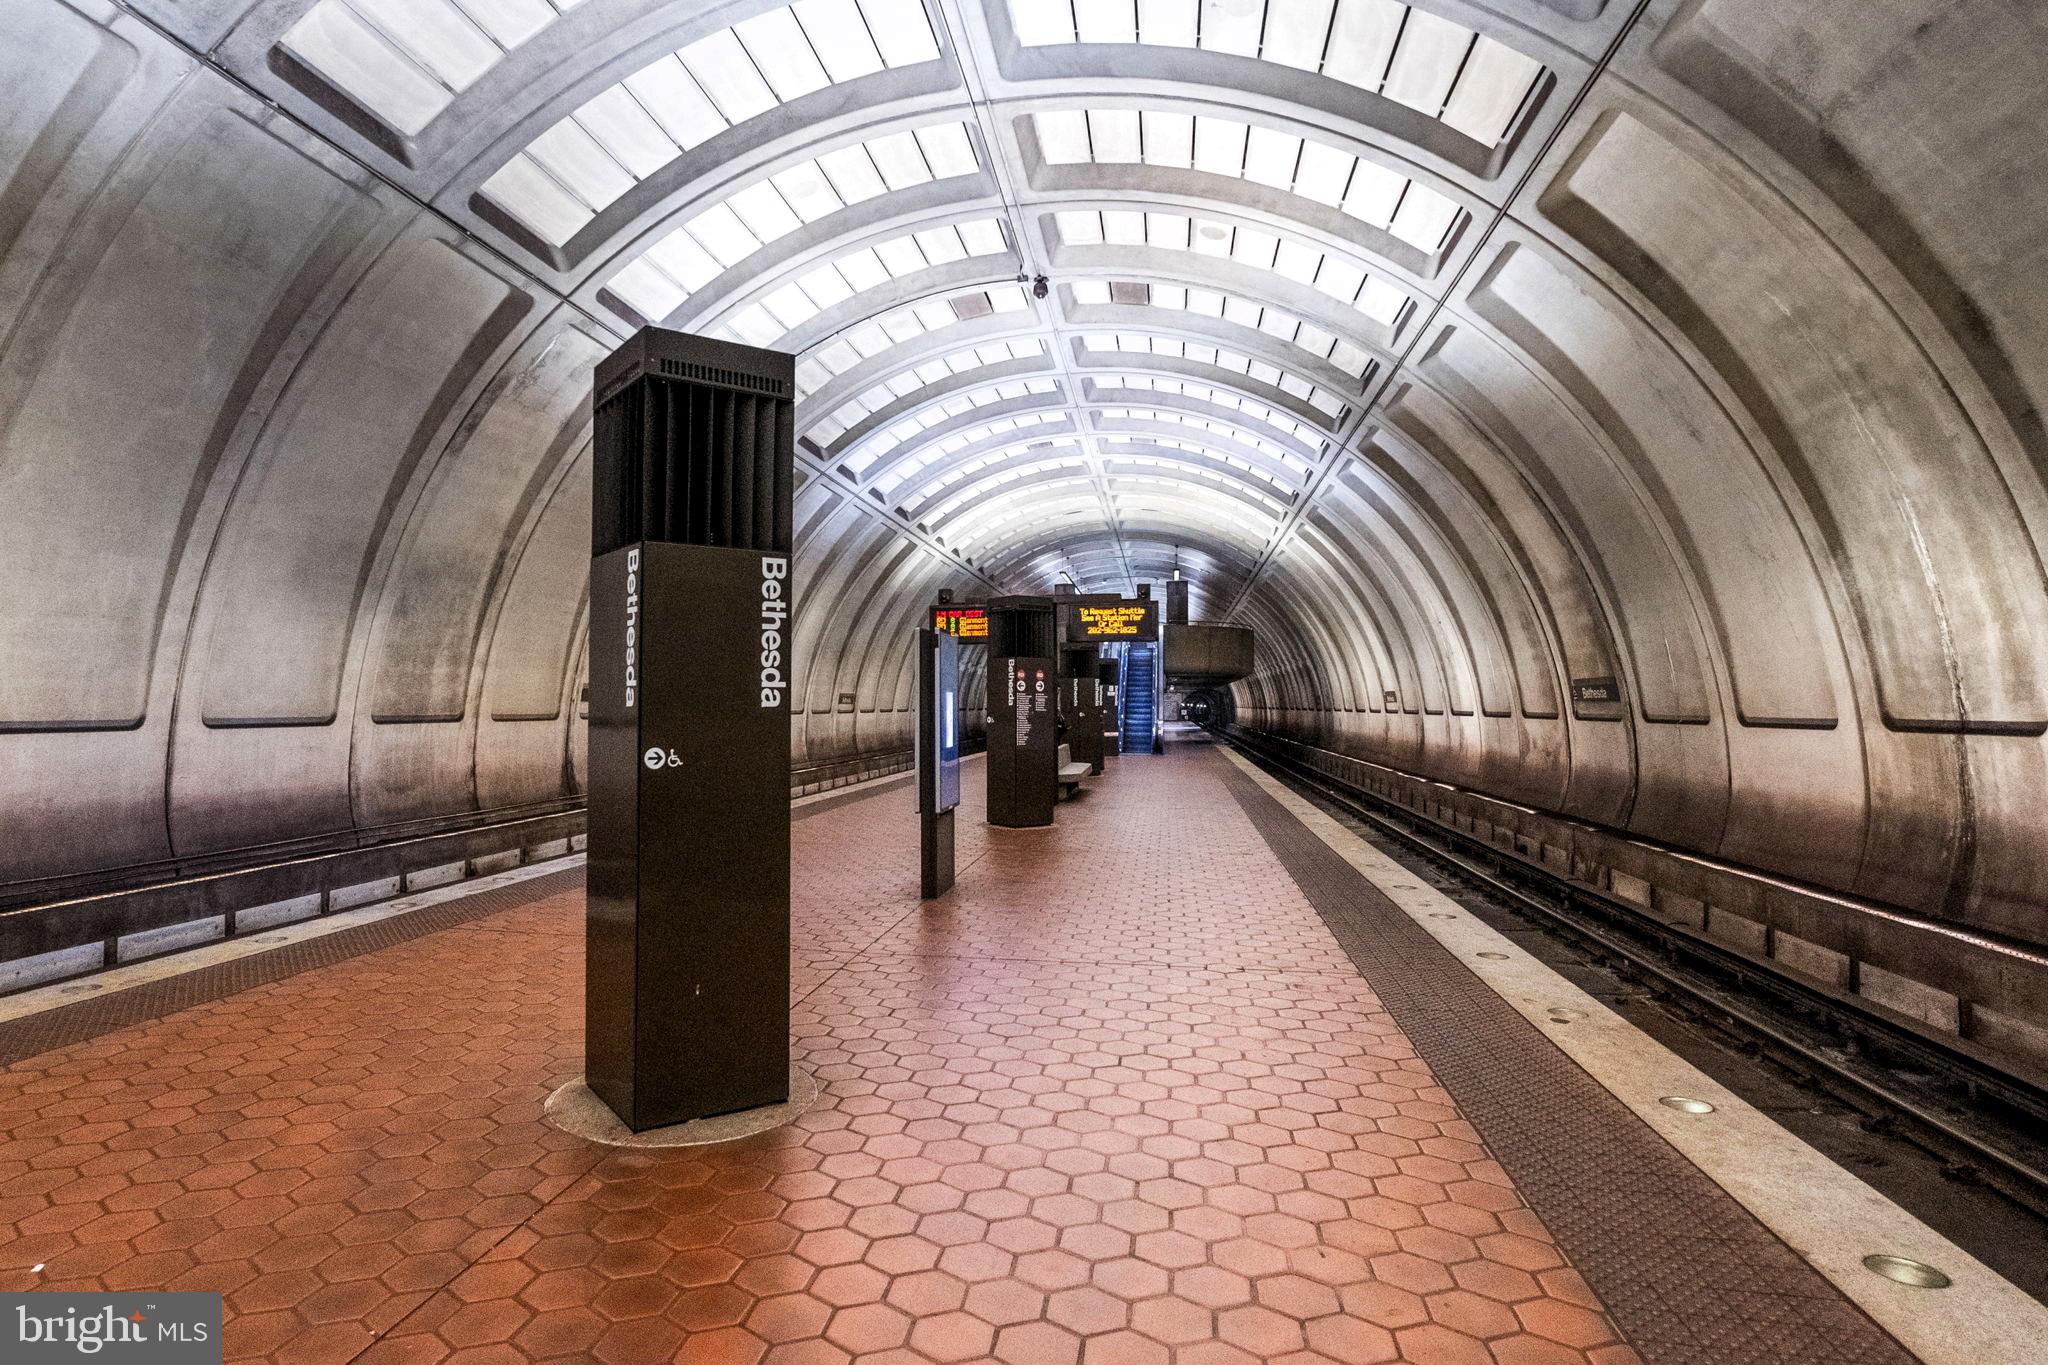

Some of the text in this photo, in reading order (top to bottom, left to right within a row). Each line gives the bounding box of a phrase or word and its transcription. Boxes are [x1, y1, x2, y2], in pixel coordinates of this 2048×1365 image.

[626, 549, 639, 707] Bethesda
[761, 556, 787, 708] Bethesda
[1080, 606, 1145, 615] To Request Shuttle
